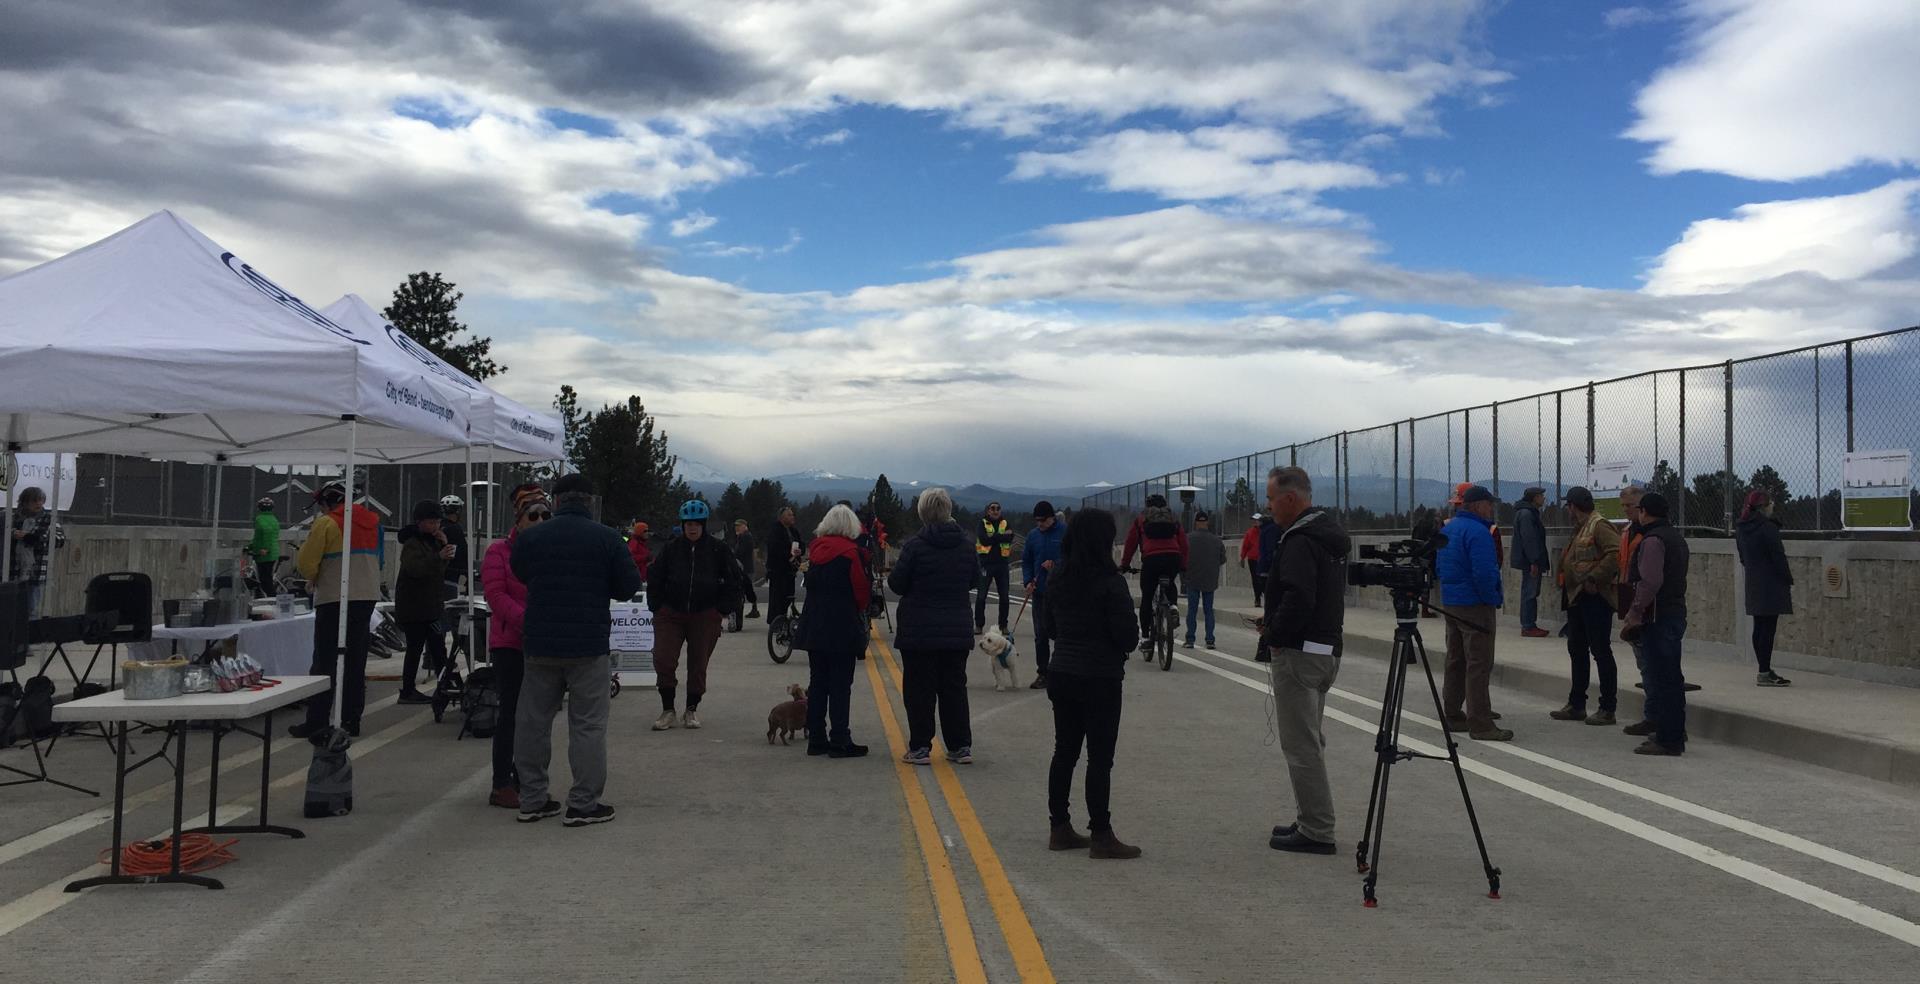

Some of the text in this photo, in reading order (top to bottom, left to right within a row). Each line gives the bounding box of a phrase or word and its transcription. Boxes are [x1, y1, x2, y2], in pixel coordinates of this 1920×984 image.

[386, 381, 397, 404] City
[398, 387, 405, 401] of
[404, 388, 417, 407] Bend
[22, 464, 41, 478] CITY
[609, 617, 654, 627] WELCOM
